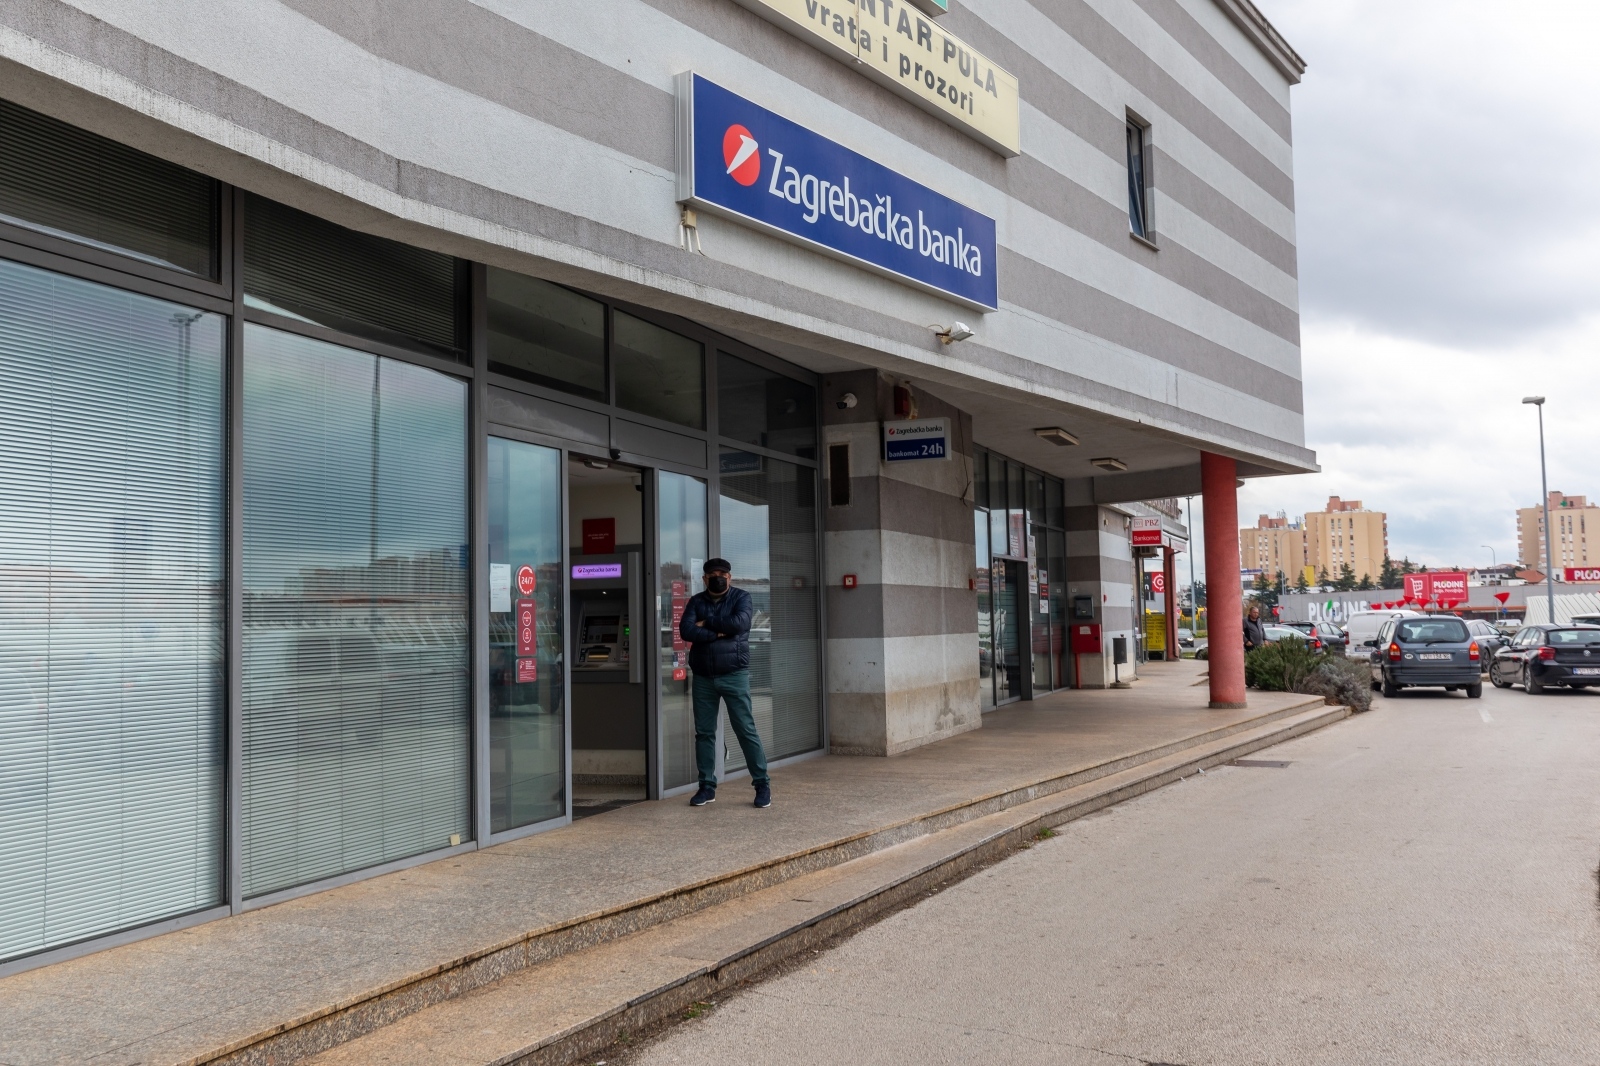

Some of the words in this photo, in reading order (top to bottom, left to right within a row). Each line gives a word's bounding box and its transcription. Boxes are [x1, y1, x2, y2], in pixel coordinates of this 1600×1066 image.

[805, 0, 871, 53] vrata
[882, 36, 888, 63] i
[899, 52, 974, 116] prozori
[943, 35, 998, 98] PULA
[768, 147, 914, 250] Zagrebačka
[918, 209, 982, 277] banka
[896, 426, 925, 435] Zagrebačka
[888, 450, 920, 458] bankomat
[921, 443, 944, 456] 24h
[1144, 519, 1160, 527] PBZ
[521, 576, 534, 585] 24/7
[1433, 580, 1464, 589] PLODINE
